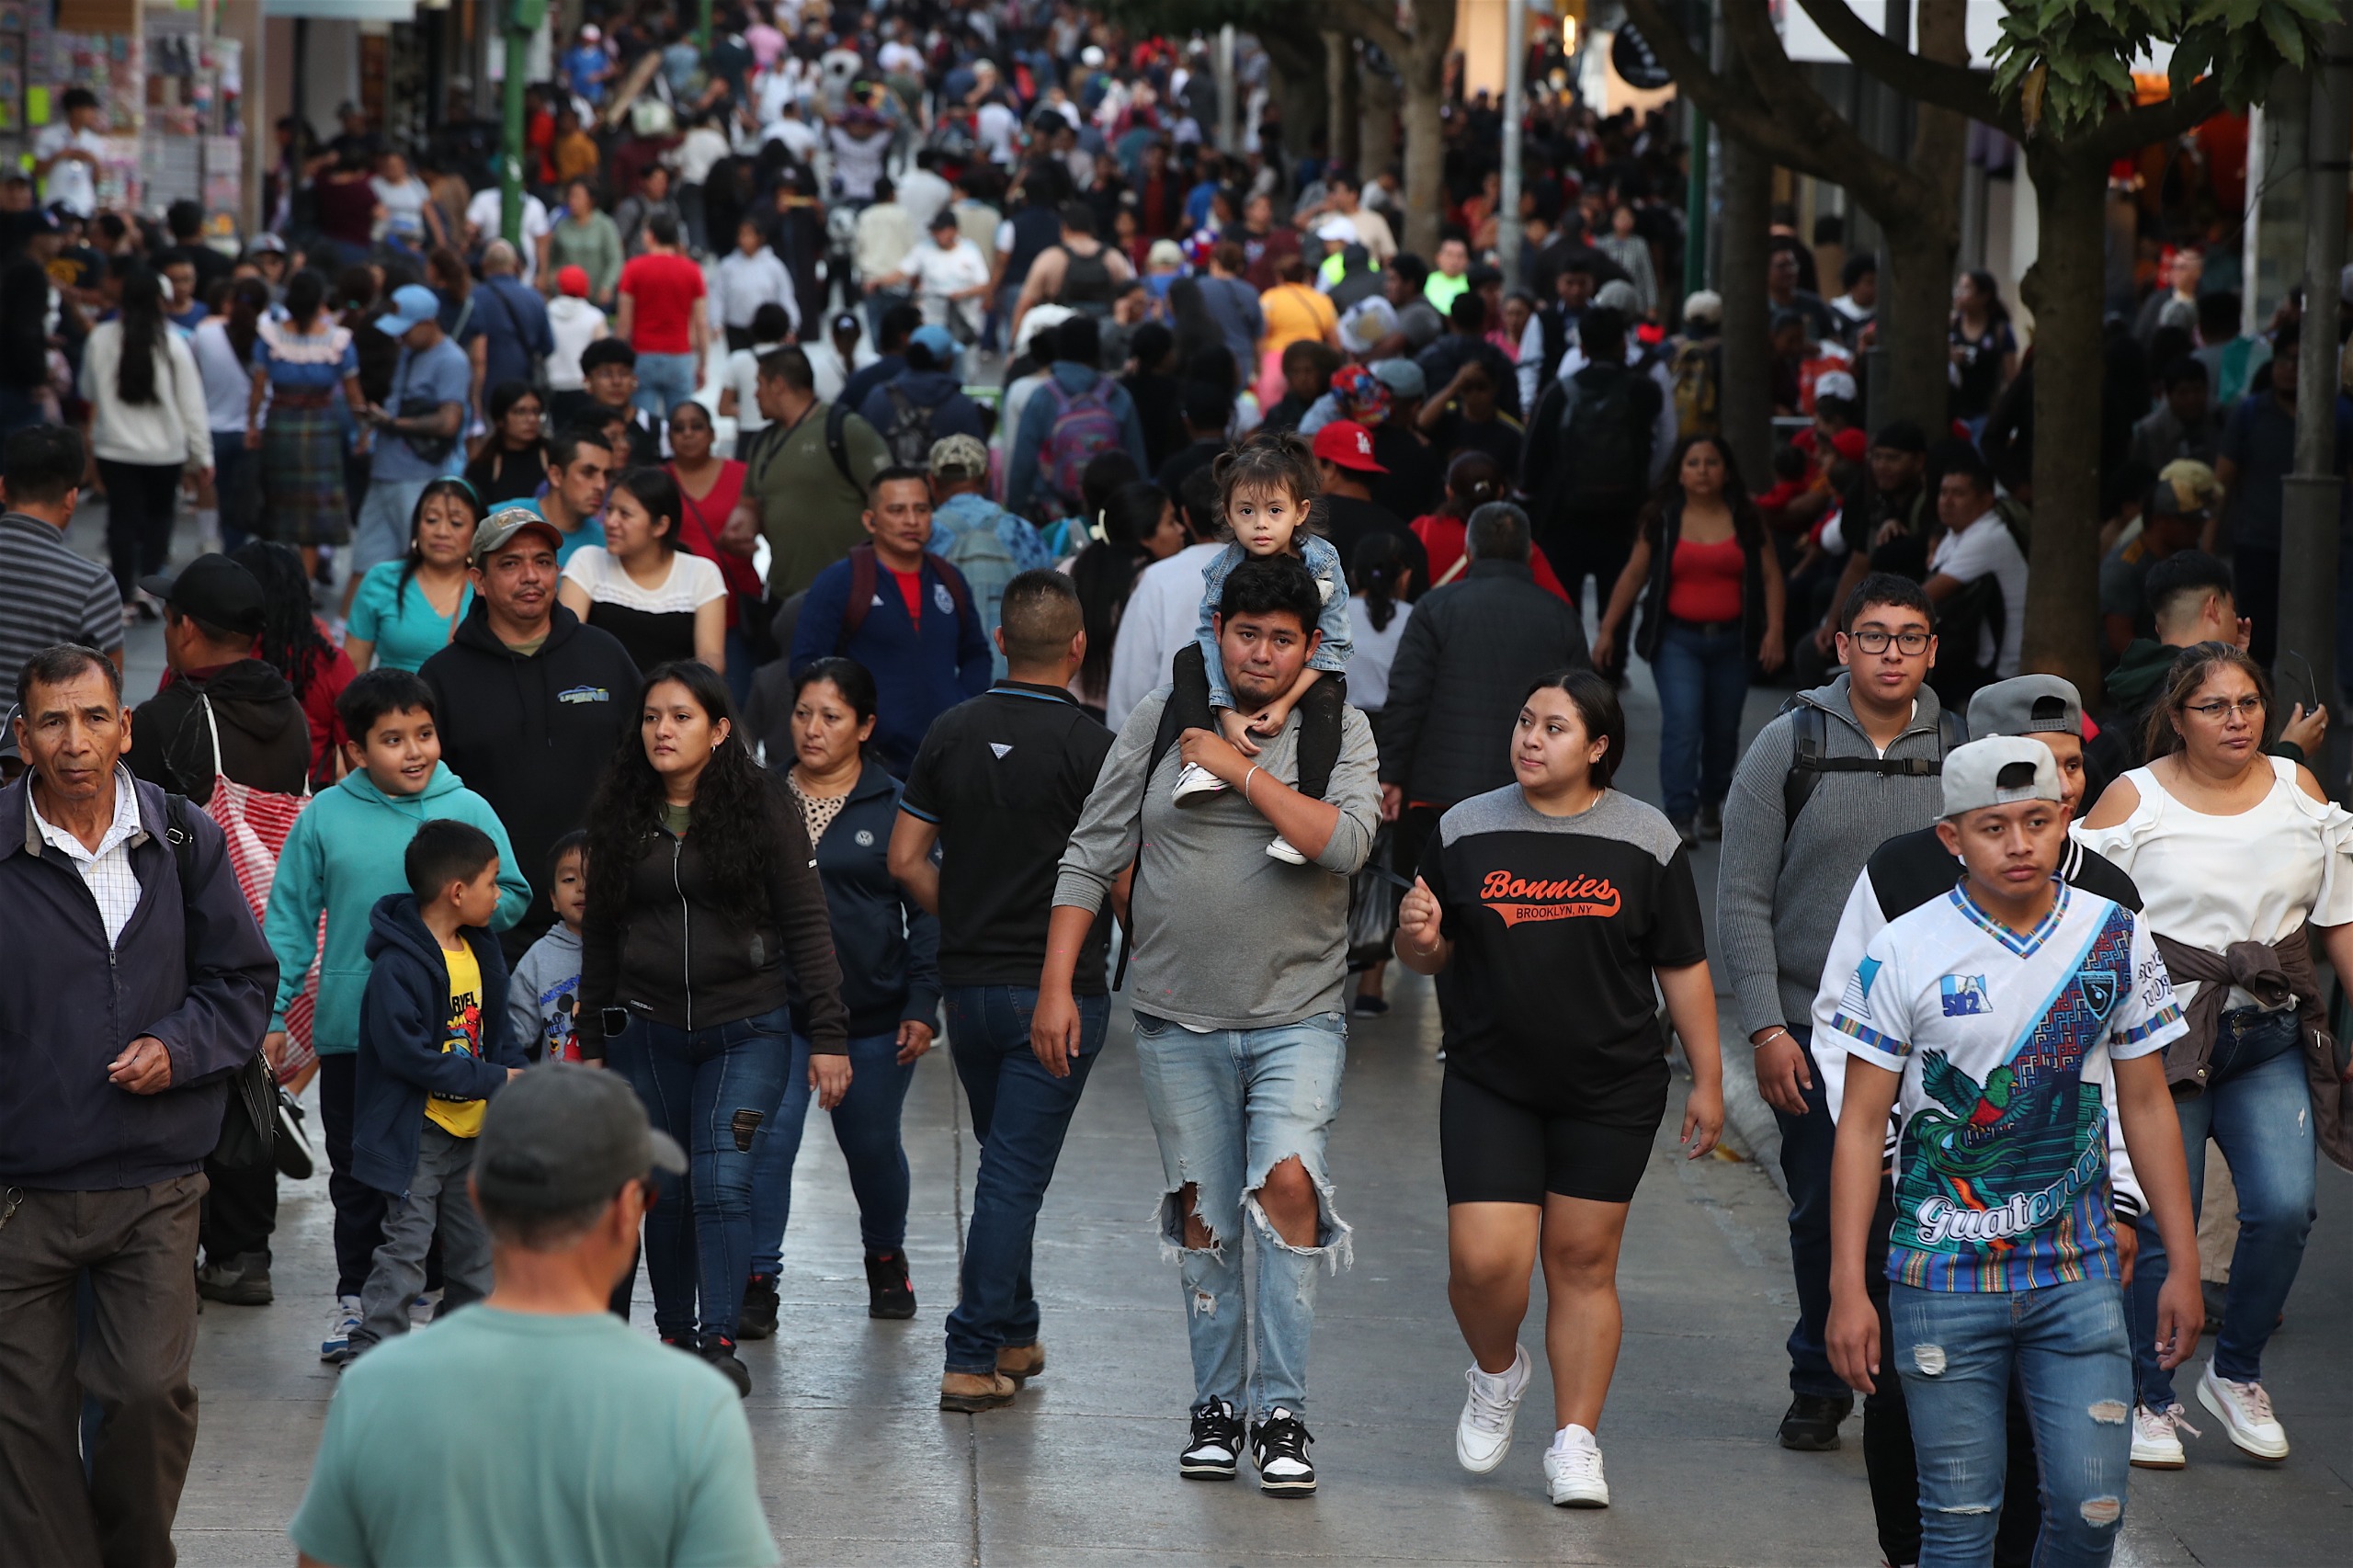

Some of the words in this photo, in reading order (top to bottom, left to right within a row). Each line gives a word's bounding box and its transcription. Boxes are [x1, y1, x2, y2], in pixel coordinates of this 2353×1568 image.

[1481, 869, 1615, 900] Bonnies
[1517, 904, 1575, 919] BROOKLYN,
[1578, 904, 1593, 915] NY
